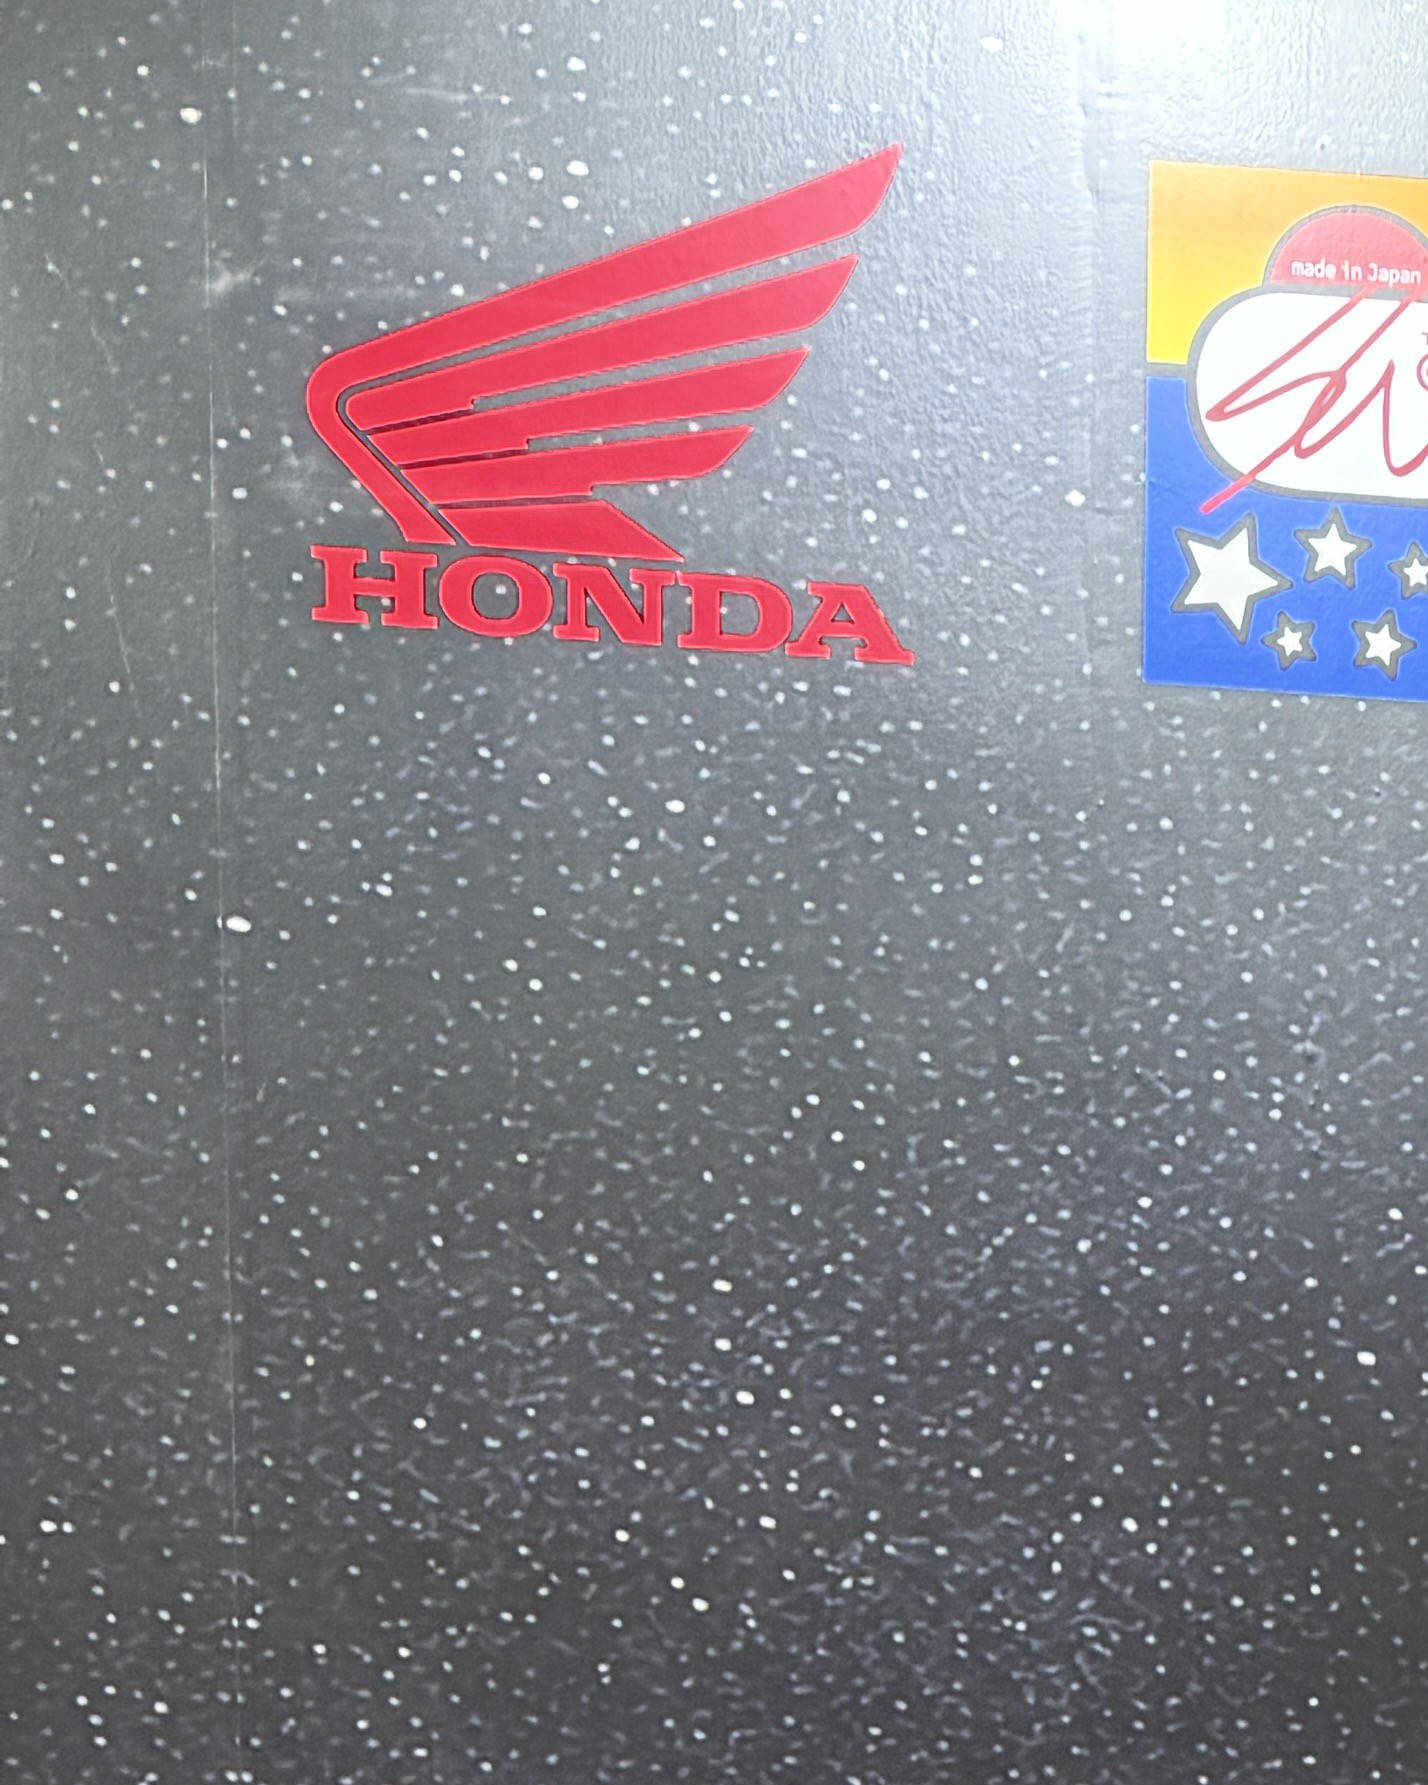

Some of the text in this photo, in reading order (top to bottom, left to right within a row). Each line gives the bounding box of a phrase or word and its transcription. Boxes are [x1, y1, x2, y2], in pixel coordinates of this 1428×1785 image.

[1291, 258, 1422, 287] made in Japan
[310, 544, 915, 666] HONDA
